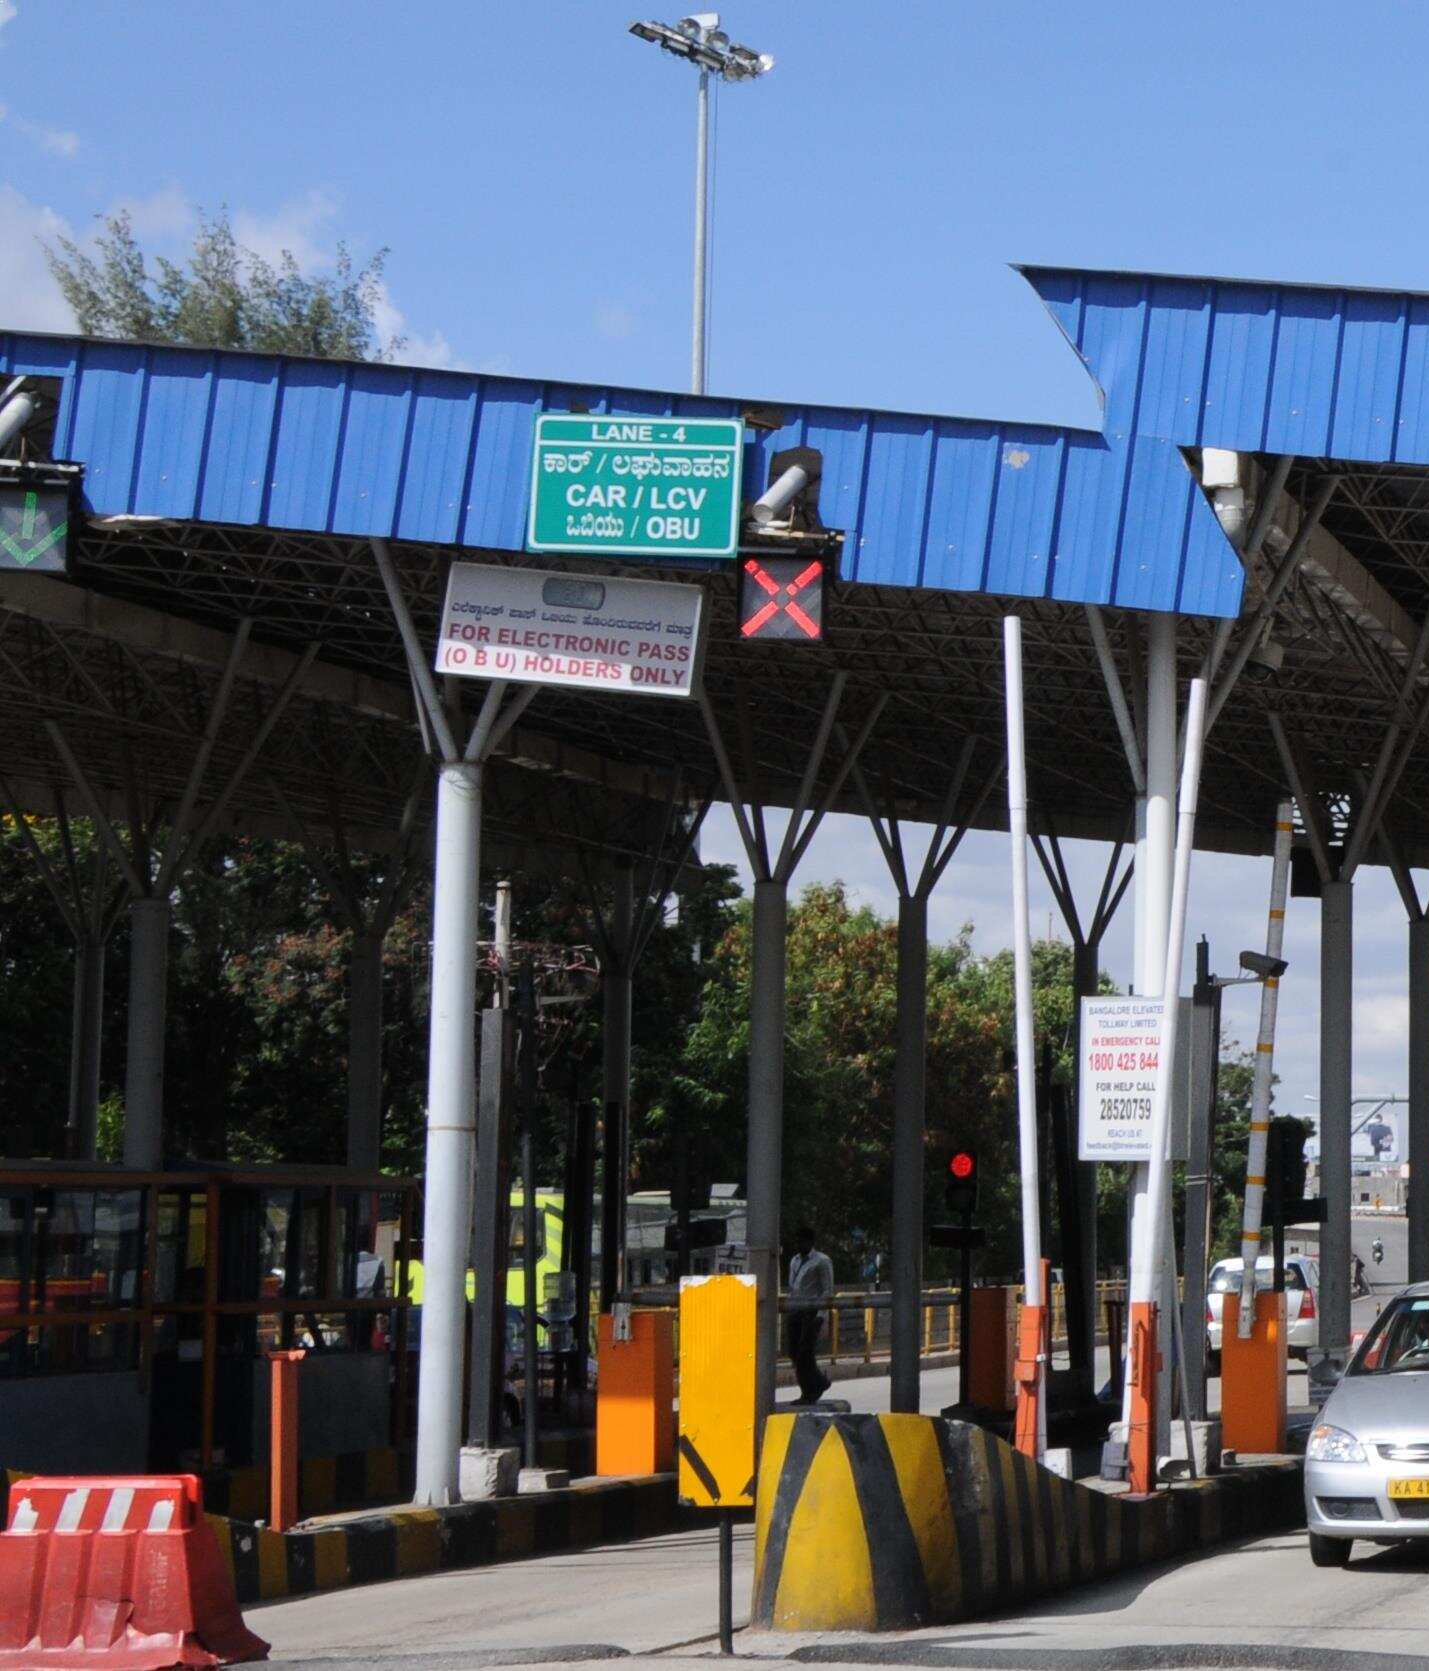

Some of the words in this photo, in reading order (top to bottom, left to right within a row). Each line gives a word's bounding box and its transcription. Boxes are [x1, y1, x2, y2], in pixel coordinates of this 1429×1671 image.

[591, 423, 653, 442] LANE
[672, 426, 686, 443] 4
[543, 450, 592, 474] ಕಾರ್
[596, 453, 607, 474] /
[565, 484, 626, 508] CAR
[632, 485, 644, 509] /
[650, 487, 707, 511] LCV
[630, 515, 640, 539] /
[646, 516, 701, 540] OBU
[448, 623, 491, 642] FOR
[497, 627, 631, 656] ELECTRONIC
[637, 642, 690, 662] PASS
[474, 649, 488, 666] B
[524, 655, 622, 680] HOLDERS
[630, 665, 685, 685] ONLY
[1101, 1036, 1143, 1046] EMERGENCY
[1088, 1053, 1114, 1071] 1800
[1117, 1053, 1137, 1071] 425
[1139, 1052, 1159, 1071] 844
[1096, 1082, 1112, 1091] FOR
[1113, 1082, 1134, 1092] HELP
[1136, 1082, 1156, 1092] CALL
[1100, 1098, 1152, 1120] 28520759
[1394, 1480, 1411, 1495] KA
